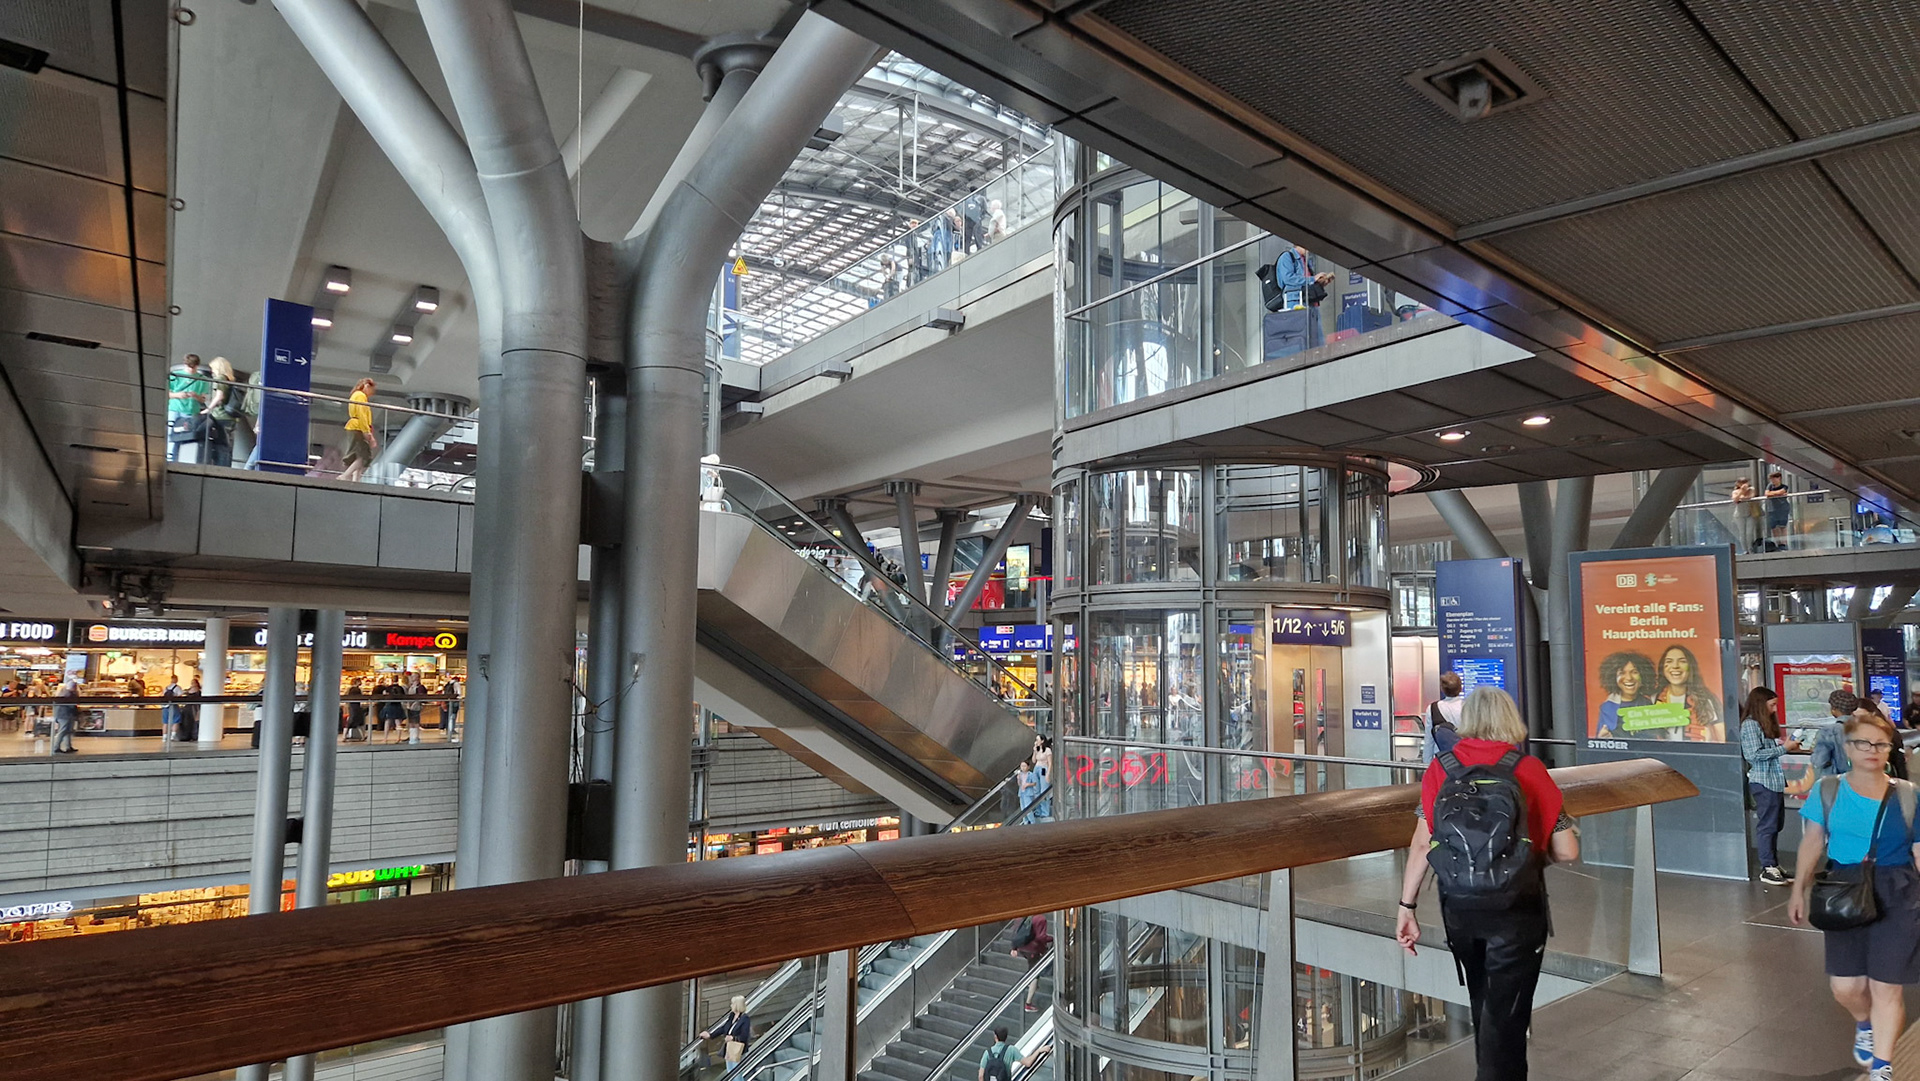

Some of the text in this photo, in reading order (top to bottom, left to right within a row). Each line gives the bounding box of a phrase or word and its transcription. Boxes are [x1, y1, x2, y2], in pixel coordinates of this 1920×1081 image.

[1618, 575, 1636, 586] DB
[1595, 602, 1704, 614] Vereint alle Fans:
[1629, 615, 1668, 626] Berlin
[11, 623, 55, 640] FOOD
[1331, 620, 1345, 635] 5/6
[108, 627, 168, 641] BURGER
[168, 629, 206, 642] KING
[386, 632, 435, 649] Kamps
[1602, 628, 1698, 641] Hauptbahnhof.
[1627, 708, 1672, 718] Ein Team.
[1629, 719, 1650, 727] Fürs
[1587, 740, 1629, 750] STRÖER
[326, 865, 421, 888] SUBWAY
